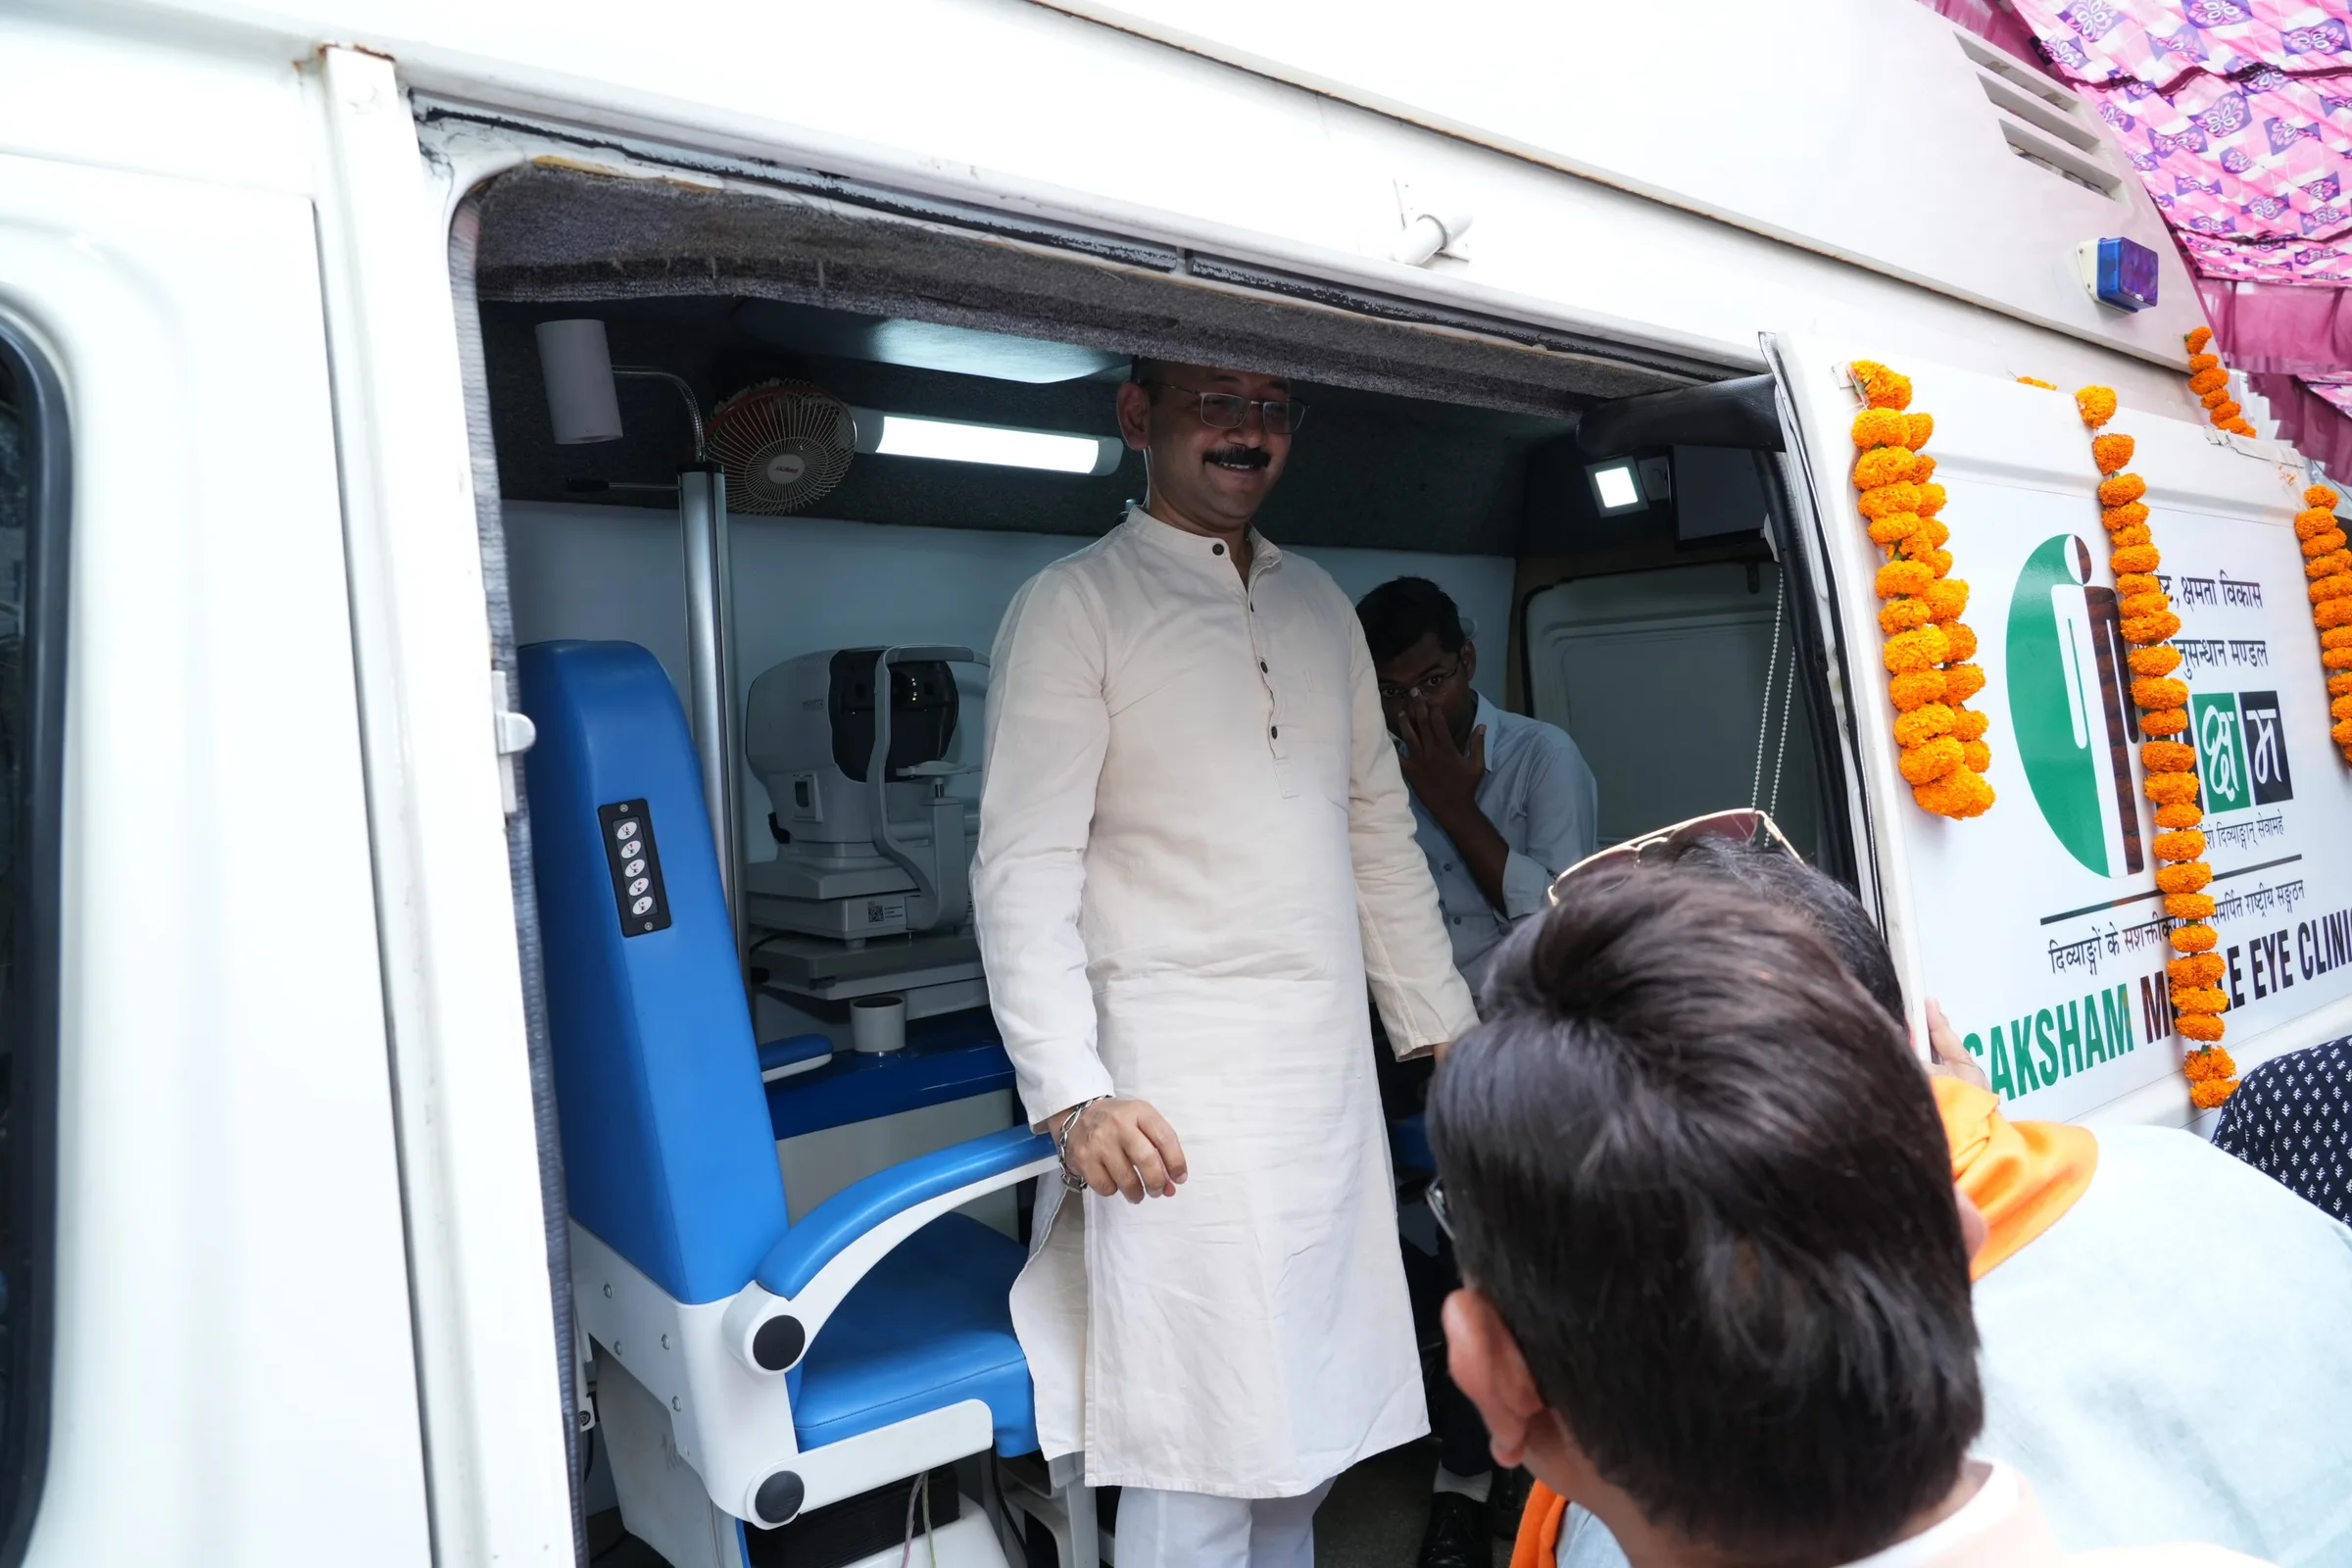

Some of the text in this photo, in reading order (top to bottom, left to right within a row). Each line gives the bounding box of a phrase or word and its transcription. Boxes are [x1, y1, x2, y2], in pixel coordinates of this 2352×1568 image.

[2180, 576, 2217, 612] क्षमता
[2219, 569, 2263, 609] विकास
[2164, 639, 2269, 680] नुसन्धान मण्डल
[2195, 700, 2285, 808] क्षम
[2105, 922, 2121, 956] के
[2244, 882, 2275, 917] राष्ट्रीय
[2249, 929, 2294, 1001] EYE
[2297, 906, 2352, 981] CLINI
